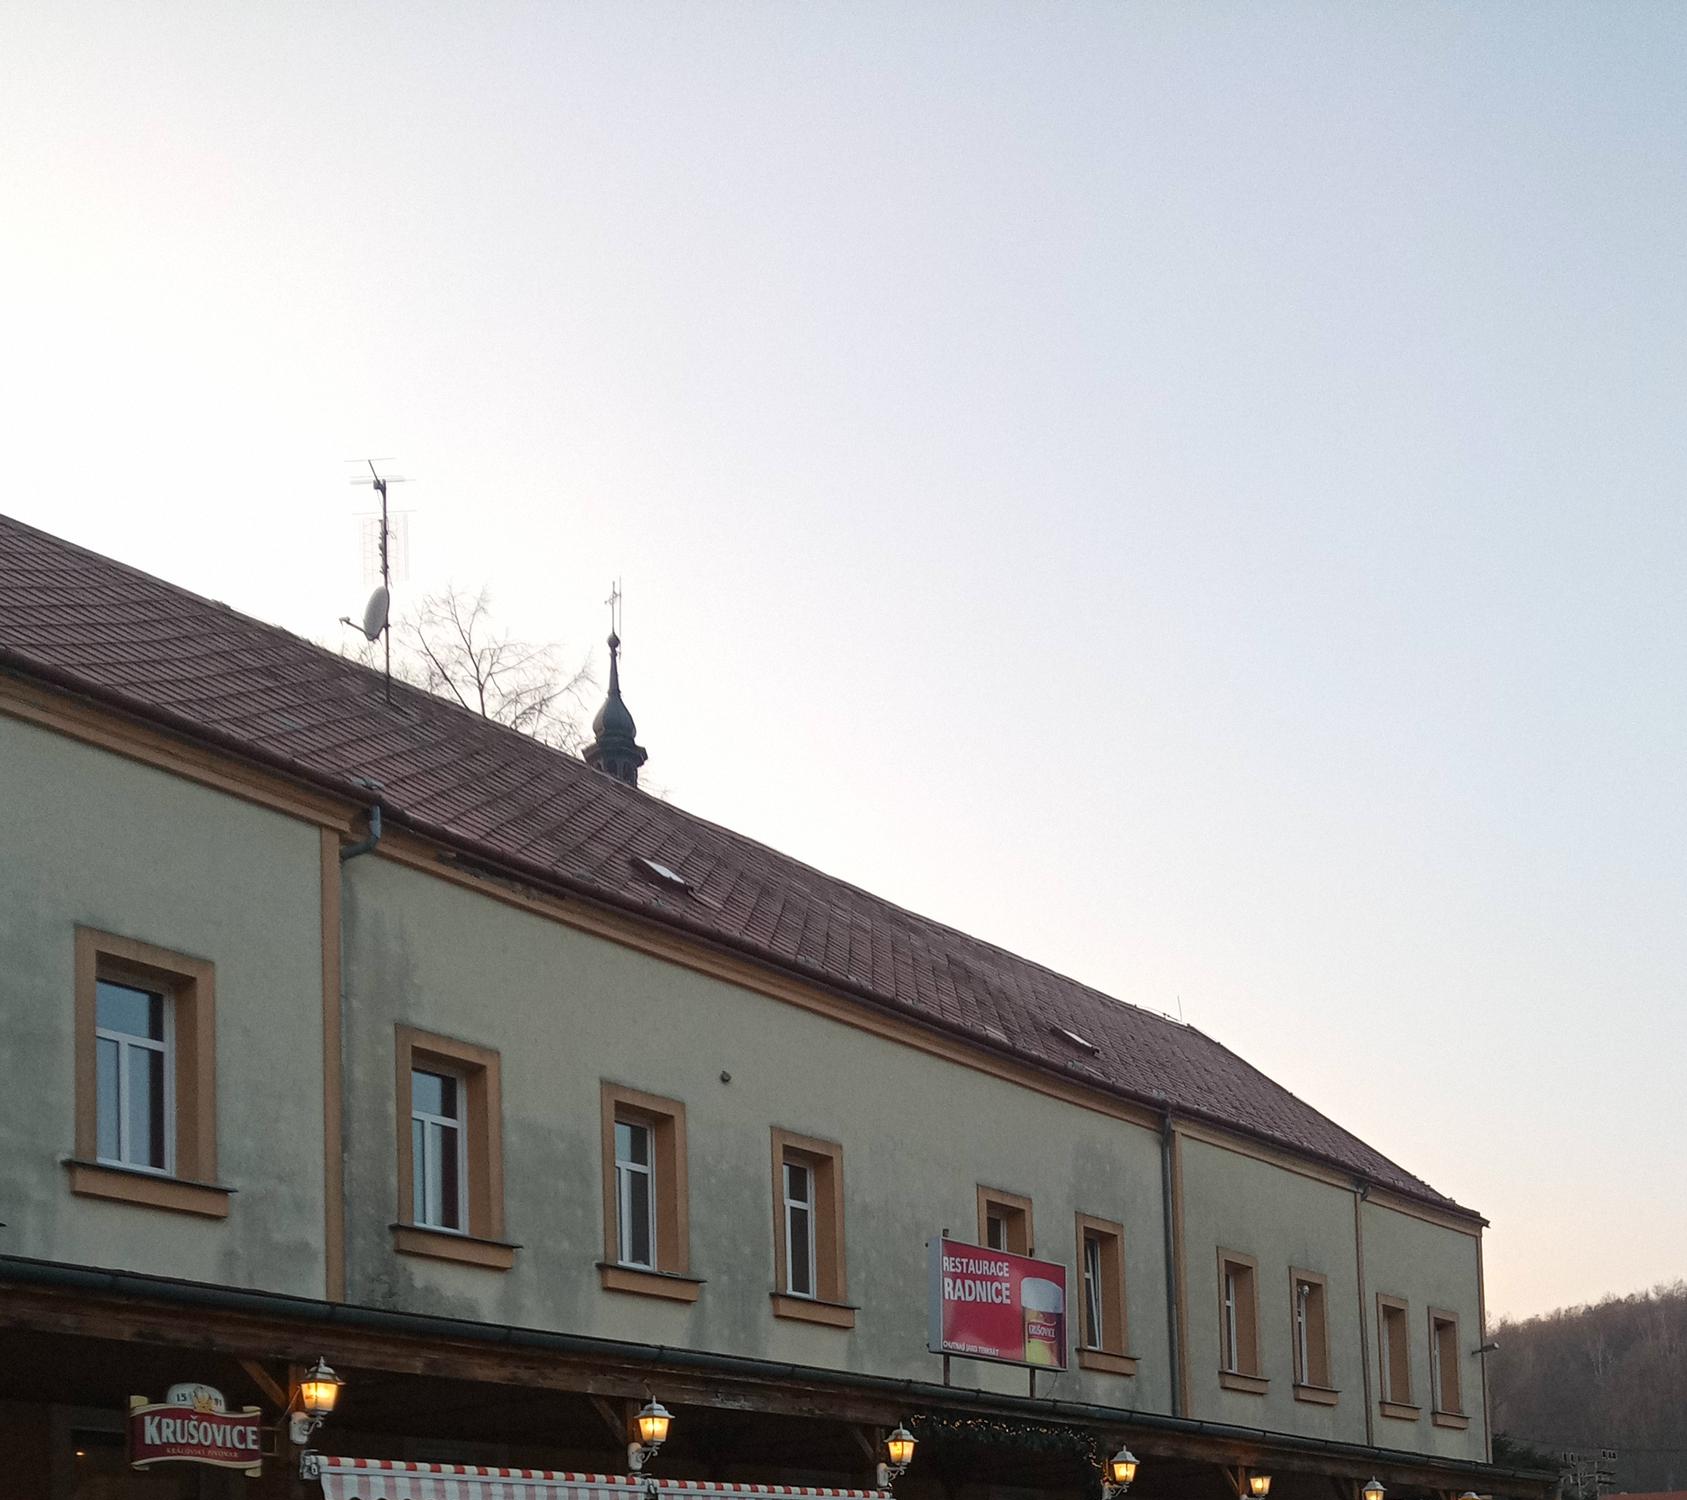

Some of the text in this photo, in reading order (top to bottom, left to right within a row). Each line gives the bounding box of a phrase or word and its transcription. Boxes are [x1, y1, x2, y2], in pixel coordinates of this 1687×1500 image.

[943, 1256, 1009, 1277] RESTAURACE
[944, 1277, 1011, 1304] RADNICE
[143, 1414, 259, 1450] KRUŠOVICE
